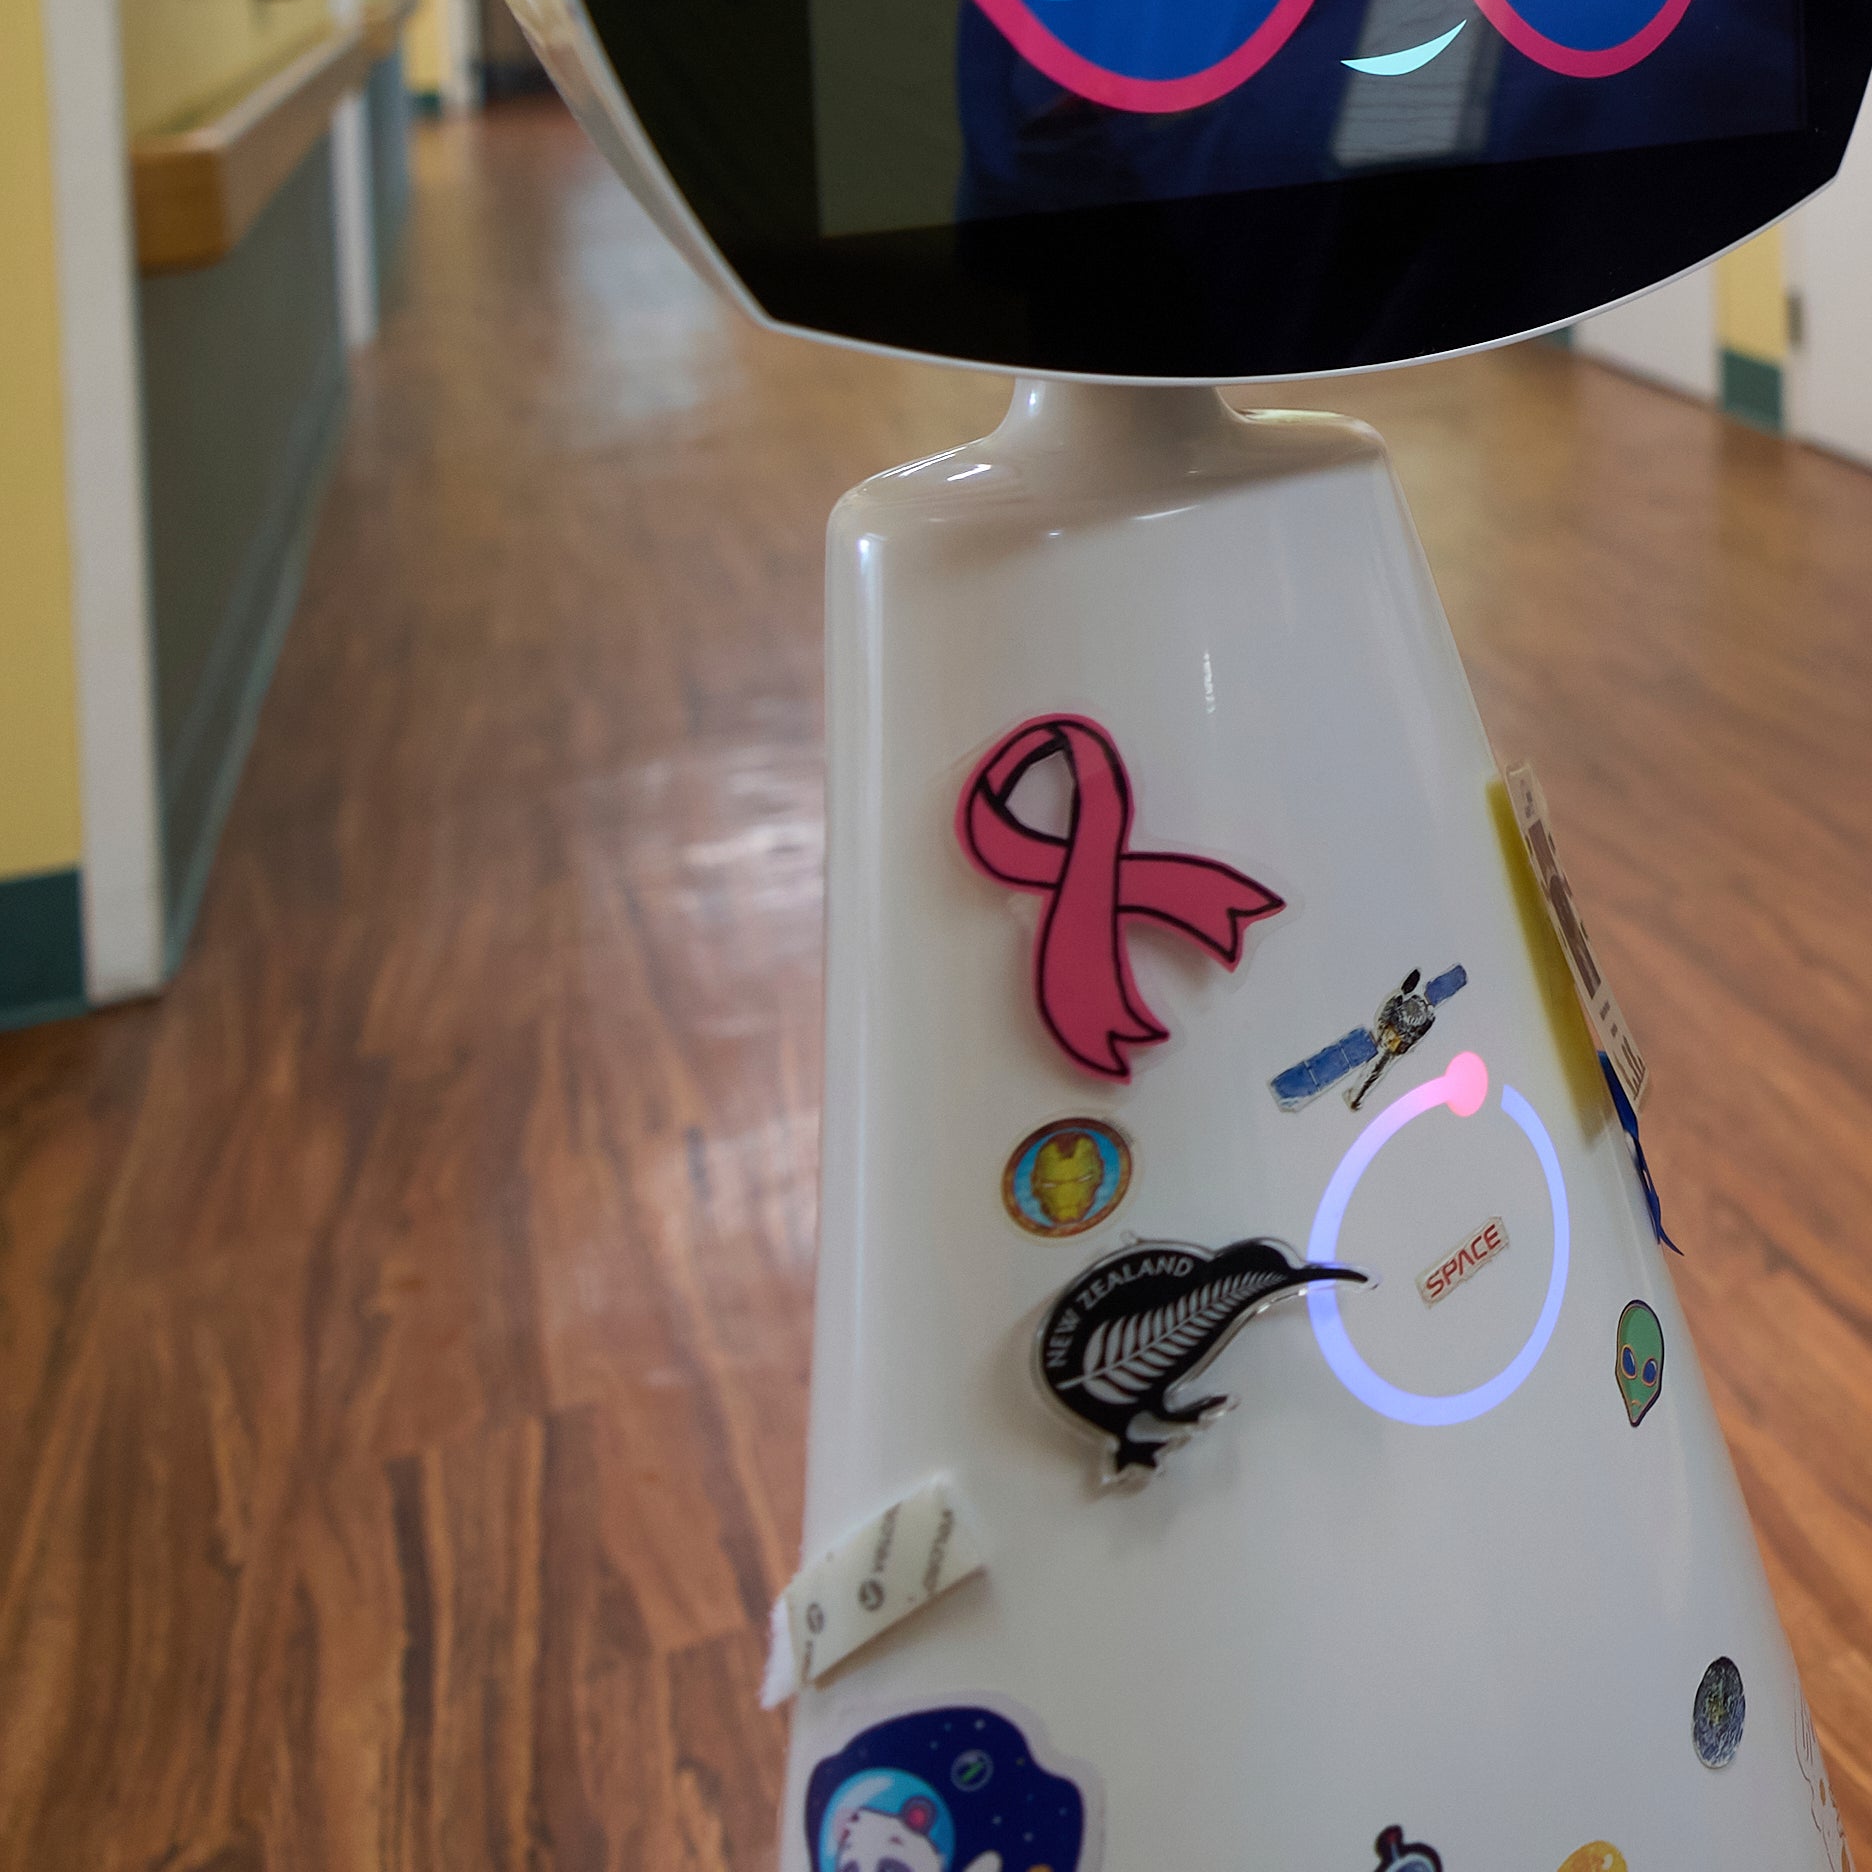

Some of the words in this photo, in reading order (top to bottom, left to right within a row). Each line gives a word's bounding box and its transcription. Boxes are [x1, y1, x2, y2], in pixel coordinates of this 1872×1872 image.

[1426, 1224, 1501, 1298] SPACE
[1046, 1308, 1081, 1369] NEW
[1076, 1255, 1195, 1311] ZEALAND
